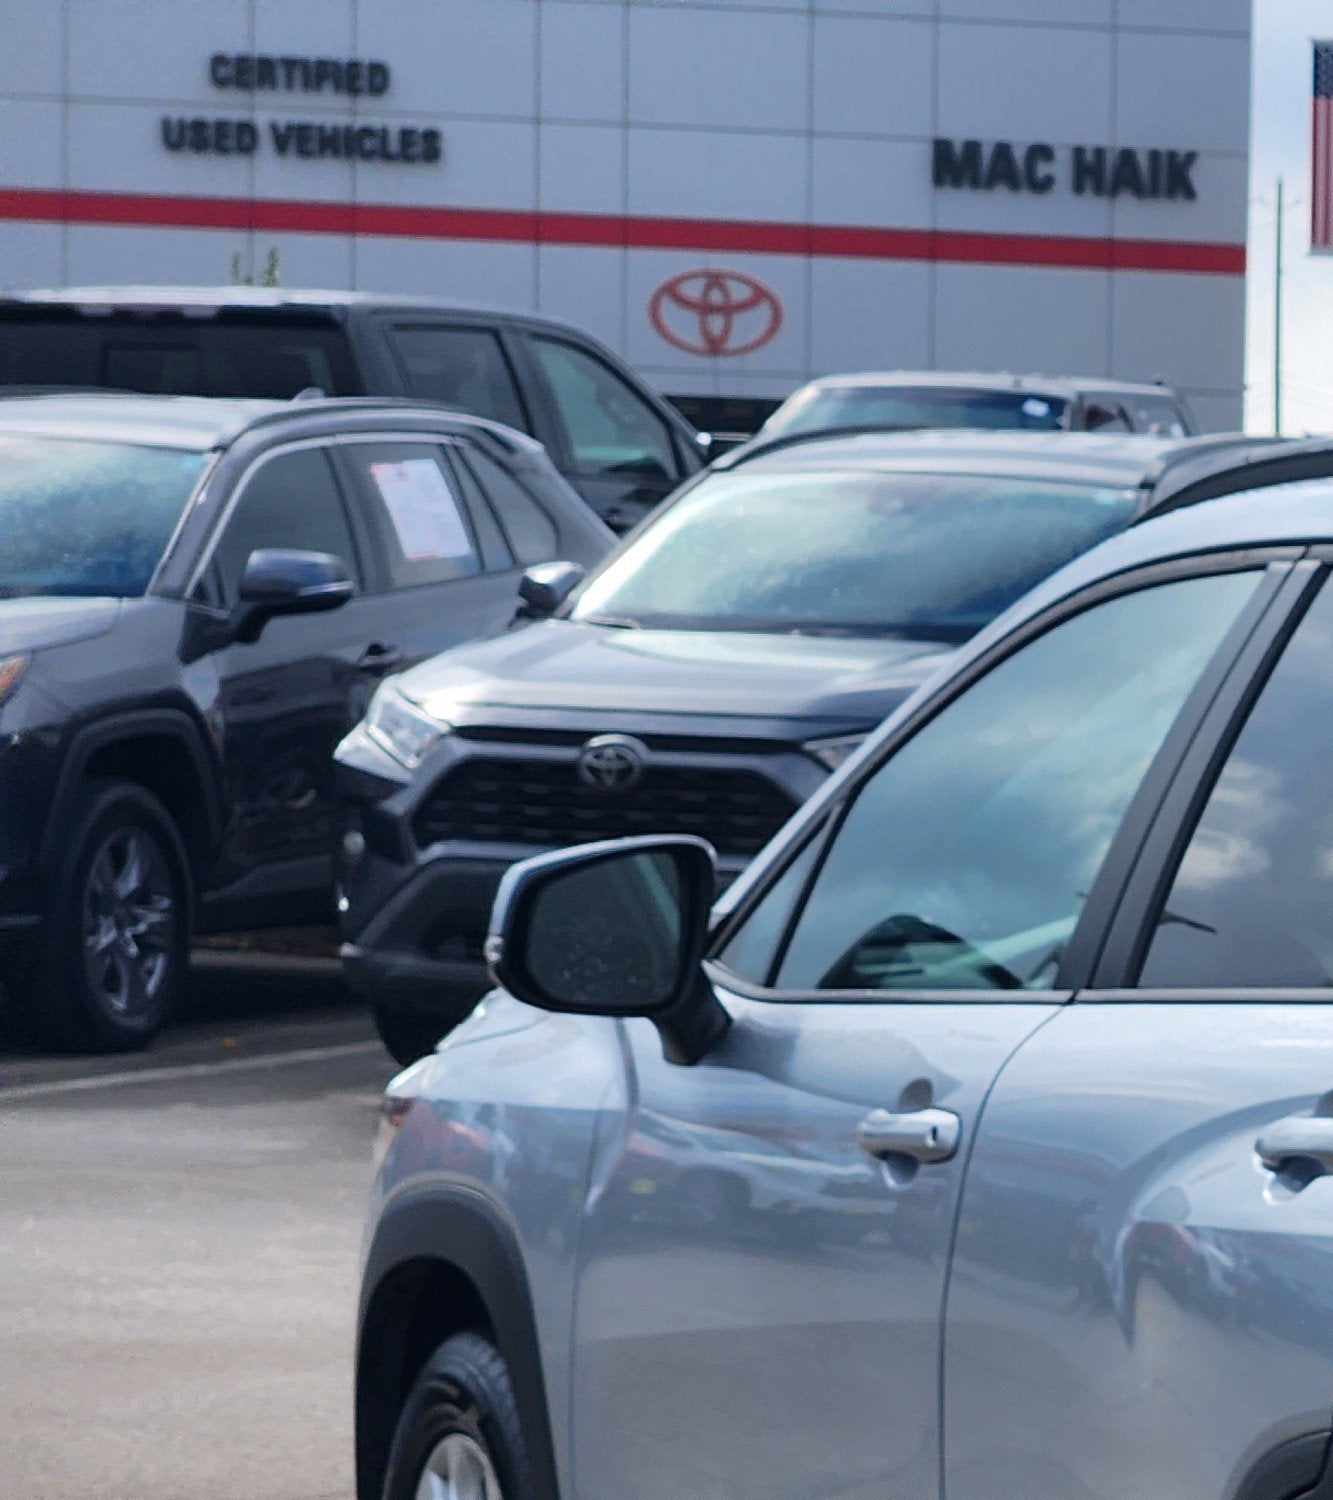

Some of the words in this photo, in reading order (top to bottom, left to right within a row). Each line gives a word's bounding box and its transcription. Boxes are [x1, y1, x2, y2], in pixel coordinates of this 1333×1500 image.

[209, 53, 391, 97] CERTIFIED
[160, 115, 259, 154] USED
[268, 119, 442, 163] VEHICLES
[931, 137, 1054, 195] MAC
[1070, 145, 1197, 202] HAIK
